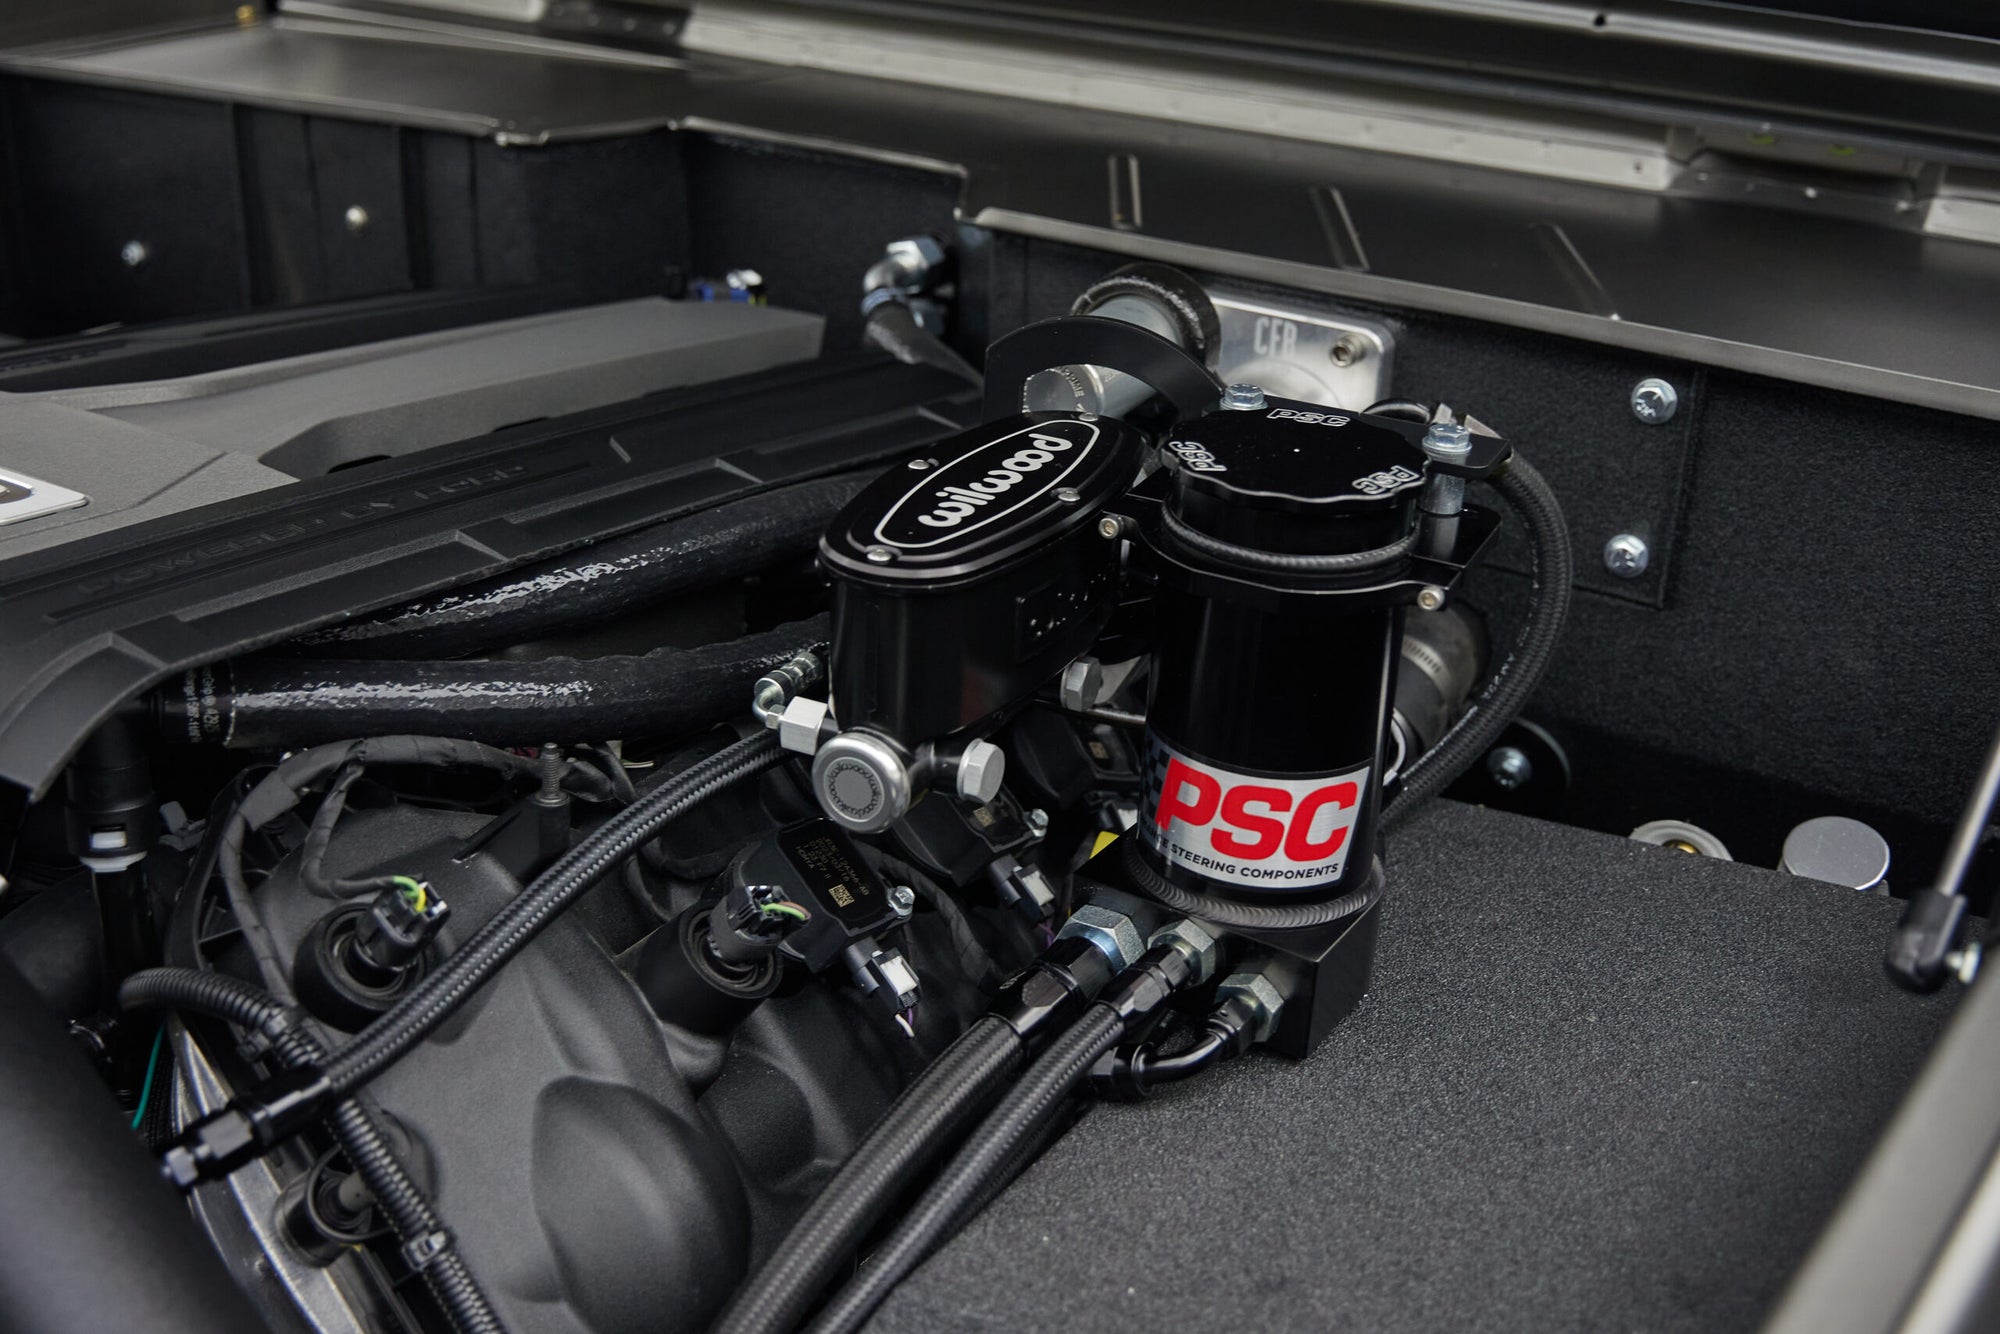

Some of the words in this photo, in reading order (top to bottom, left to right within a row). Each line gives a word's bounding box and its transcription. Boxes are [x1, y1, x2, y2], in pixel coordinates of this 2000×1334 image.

[1266, 408, 1351, 427] PSC
[1168, 441, 1227, 472] PSC
[918, 433, 1072, 528] wilwood
[1352, 465, 1421, 494] PSC
[1155, 757, 1358, 862] PSC
[1171, 843, 1235, 874] STEERING
[1240, 863, 1339, 880] COMPONENTS
